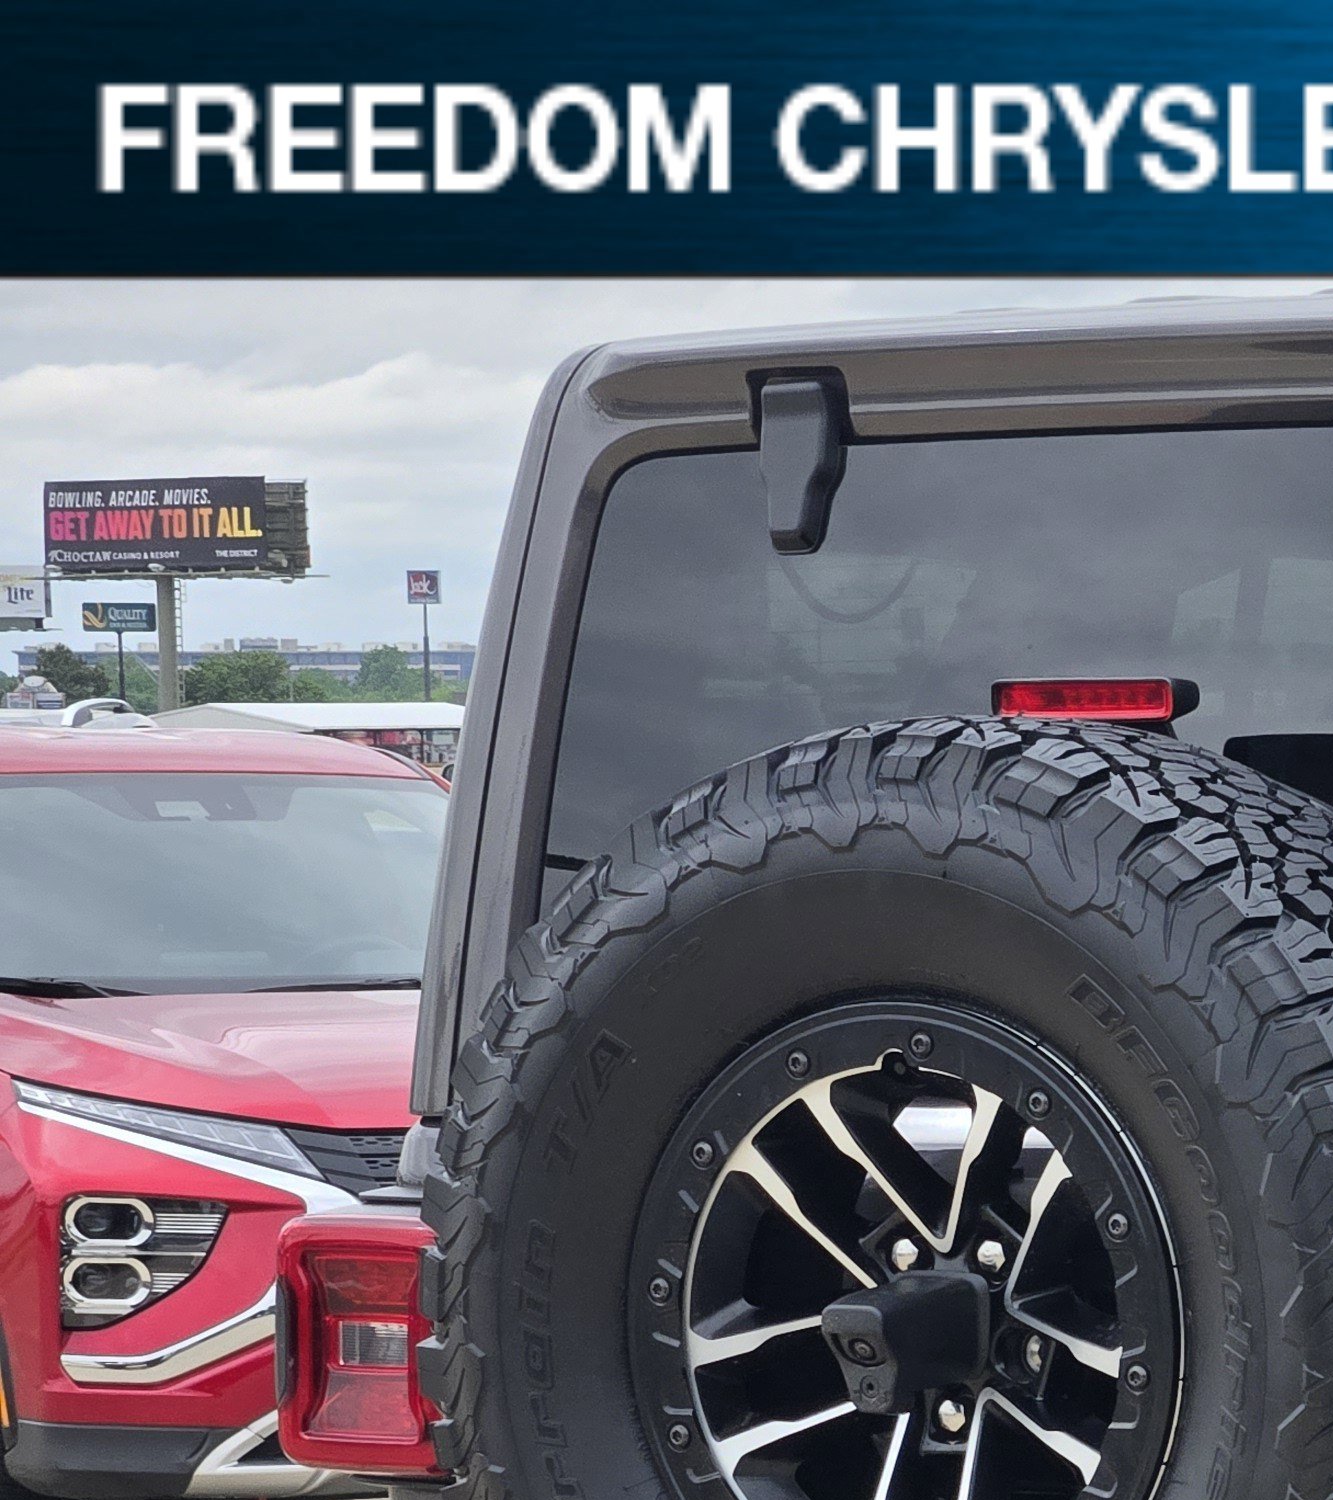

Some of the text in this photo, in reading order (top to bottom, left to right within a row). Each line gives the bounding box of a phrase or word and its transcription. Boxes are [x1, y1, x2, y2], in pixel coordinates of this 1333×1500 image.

[48, 488, 212, 508] BOWLING. ARCADE. MOVIES.
[49, 506, 263, 541] GET AWAY TO IT ALL.
[54, 549, 112, 563] CHOCTAW
[6, 585, 35, 604] Lite
[108, 606, 148, 621] QUALITY
